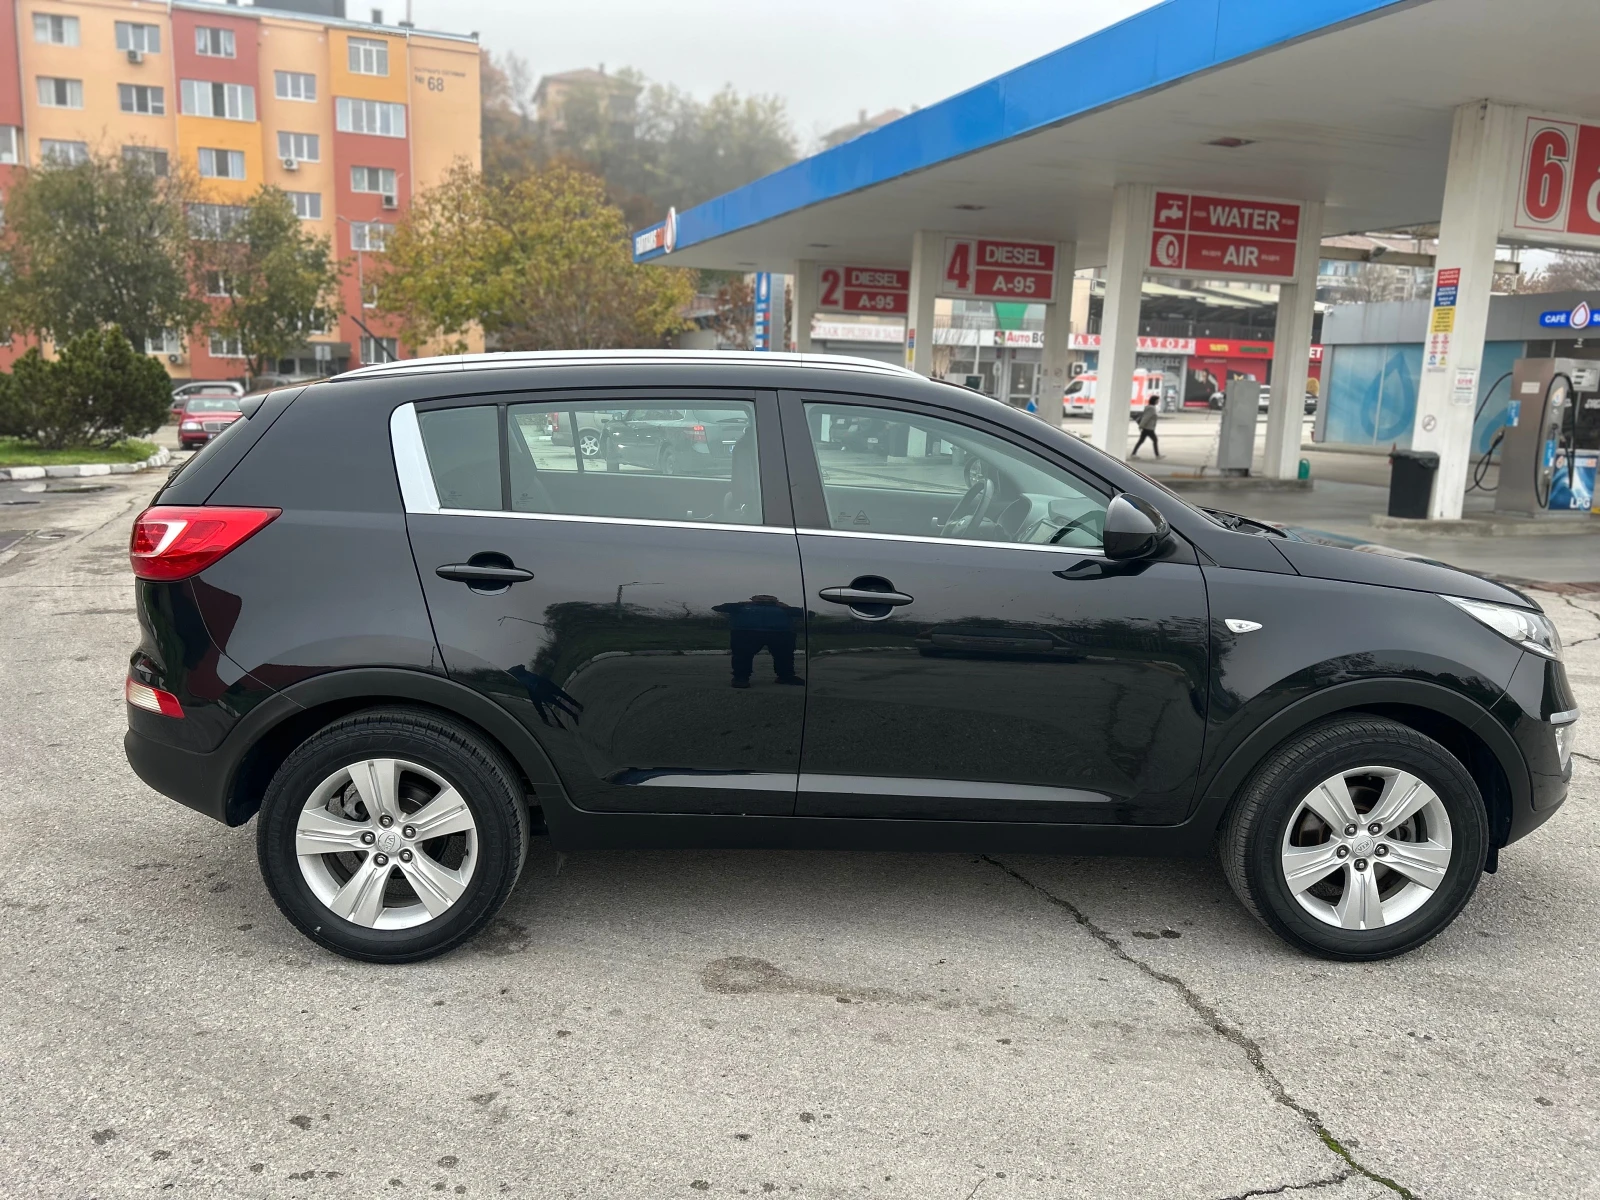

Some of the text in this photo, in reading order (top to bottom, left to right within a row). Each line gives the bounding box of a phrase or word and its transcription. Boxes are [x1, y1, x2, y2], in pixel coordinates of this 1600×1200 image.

[428, 77, 444, 92] 68
[1524, 127, 1570, 223] 6
[1209, 204, 1280, 231] WATER
[947, 243, 1045, 289] 4 DIESEL
[1223, 245, 1259, 267] AIR
[821, 268, 902, 307] 2 DIESEL
[992, 274, 1036, 294] A-95
[858, 293, 894, 310] A-95
[1545, 312, 1567, 323] CAFÉ
[1570, 497, 1590, 508] LPG
